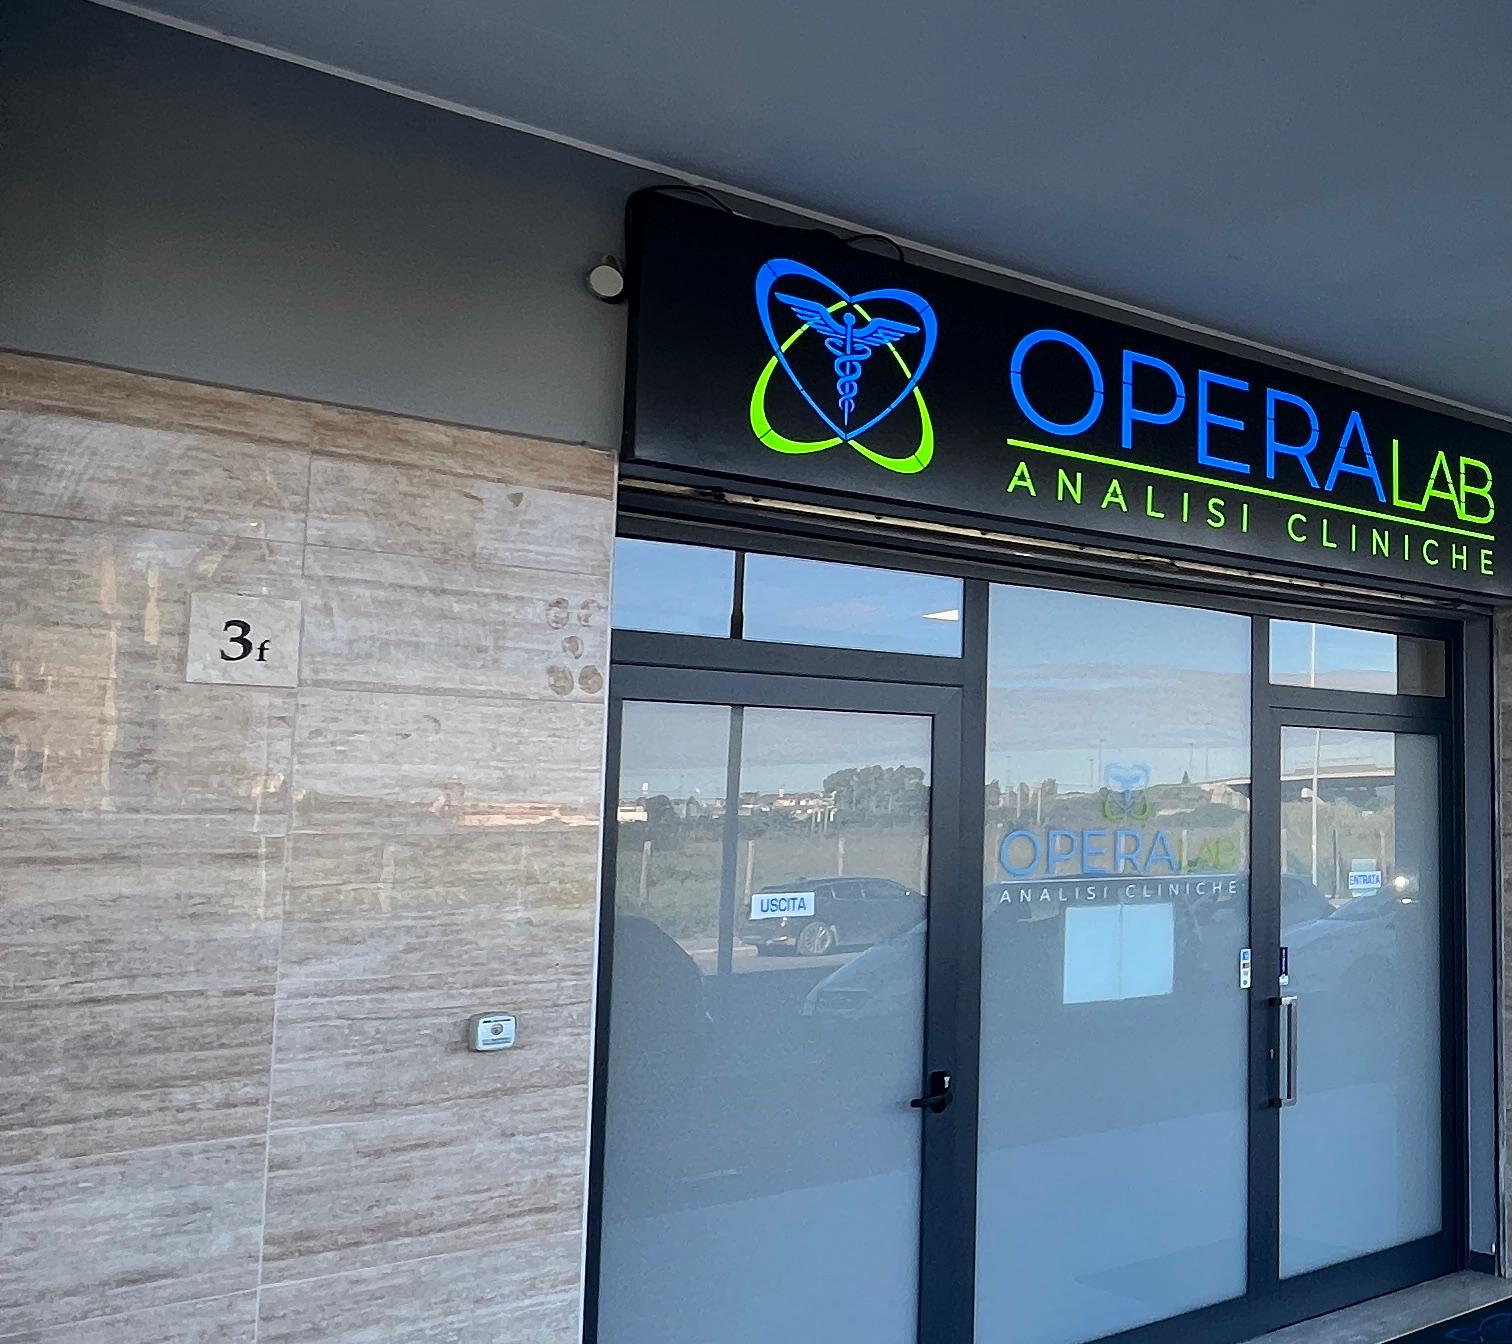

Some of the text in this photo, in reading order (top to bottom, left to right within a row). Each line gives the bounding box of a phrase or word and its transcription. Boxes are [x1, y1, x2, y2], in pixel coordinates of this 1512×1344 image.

[1010, 328, 1495, 524] OPERALAB
[1007, 461, 1494, 577] ANALISI CLINICHE
[220, 619, 271, 662] 3f
[760, 897, 807, 913] USCITA
[999, 880, 1237, 904] ANALISI CLINICHE
